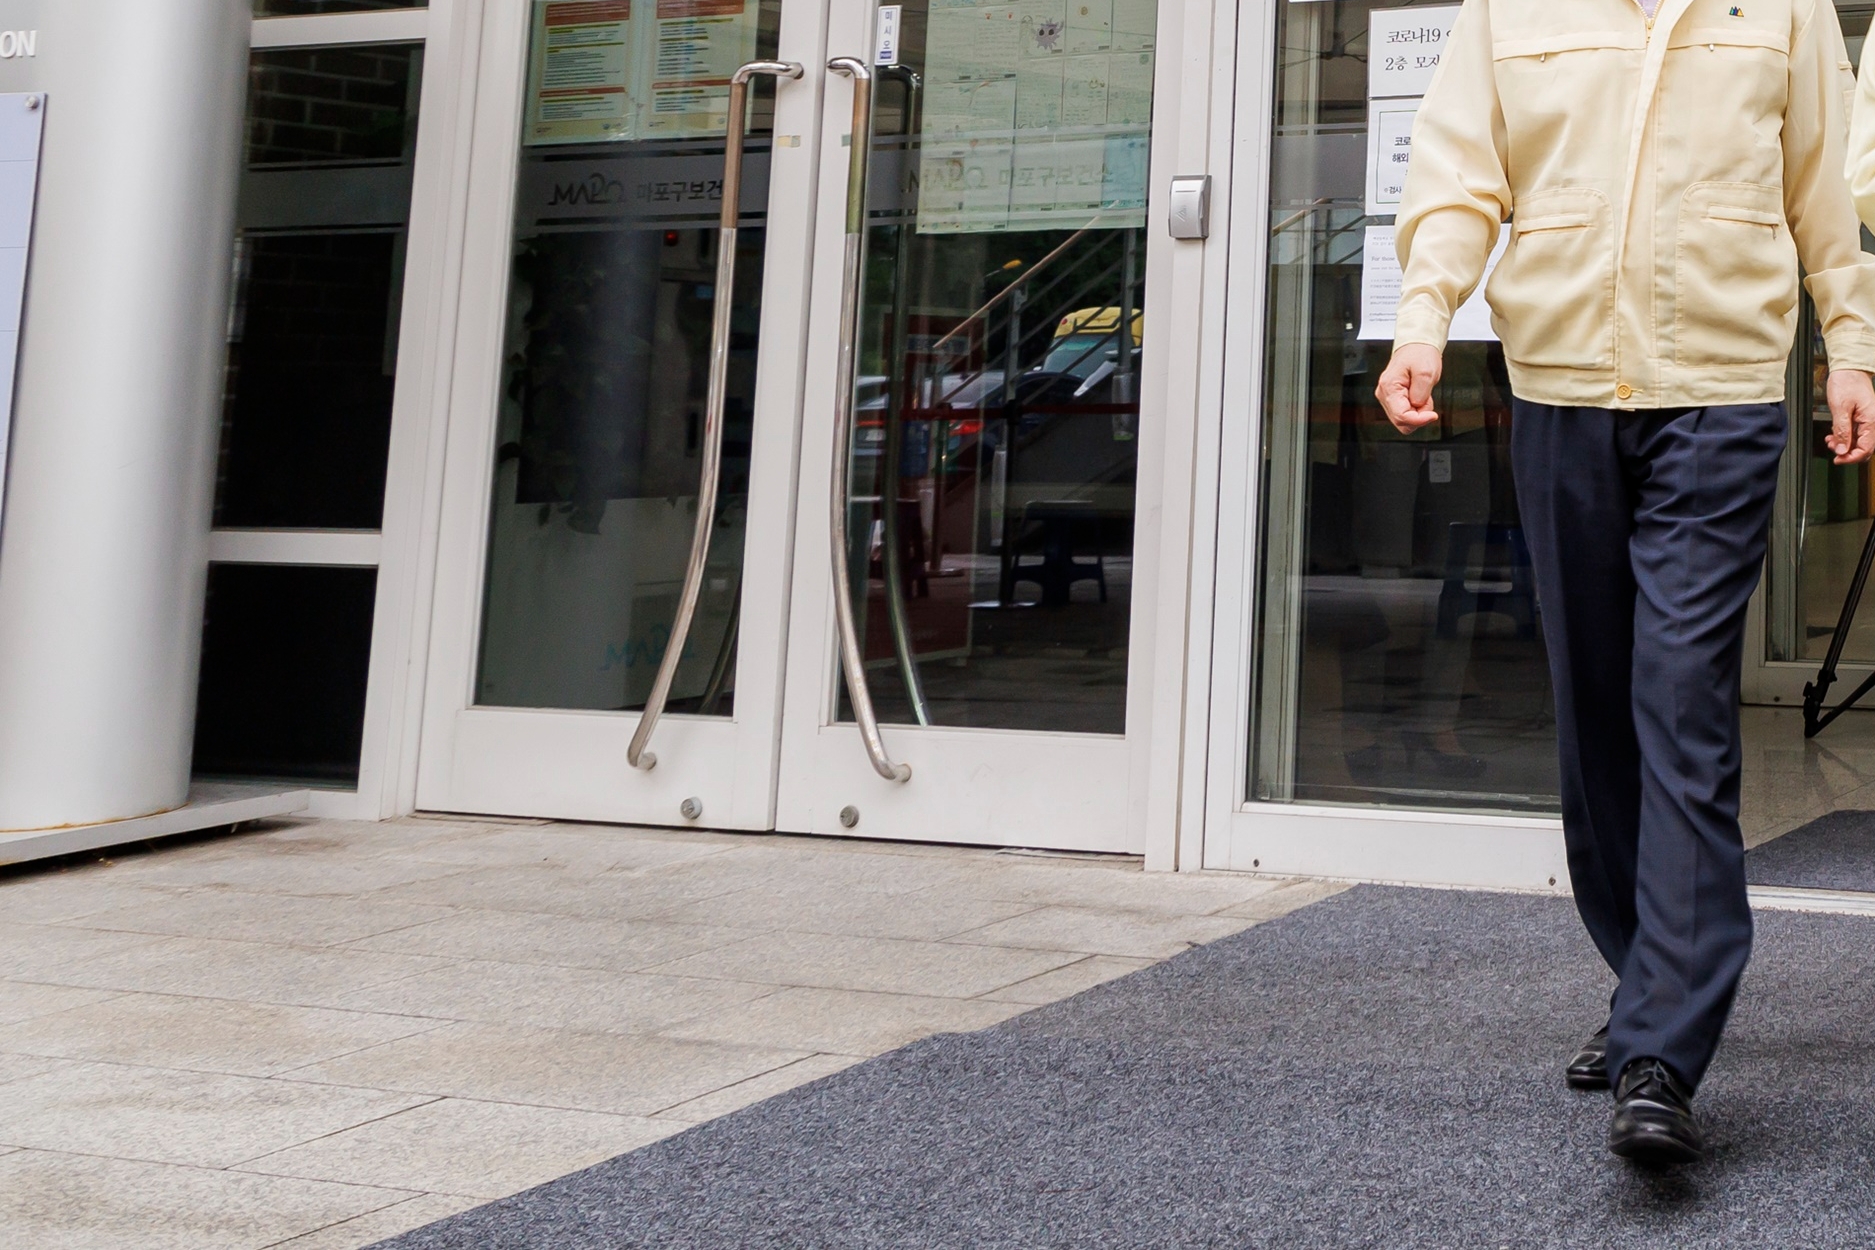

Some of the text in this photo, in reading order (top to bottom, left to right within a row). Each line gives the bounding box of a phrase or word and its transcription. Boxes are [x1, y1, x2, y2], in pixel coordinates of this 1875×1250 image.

[1386, 27, 1441, 45] 코로나19
[1385, 55, 1408, 71] 2층
[636, 179, 723, 203] 마포구보건
